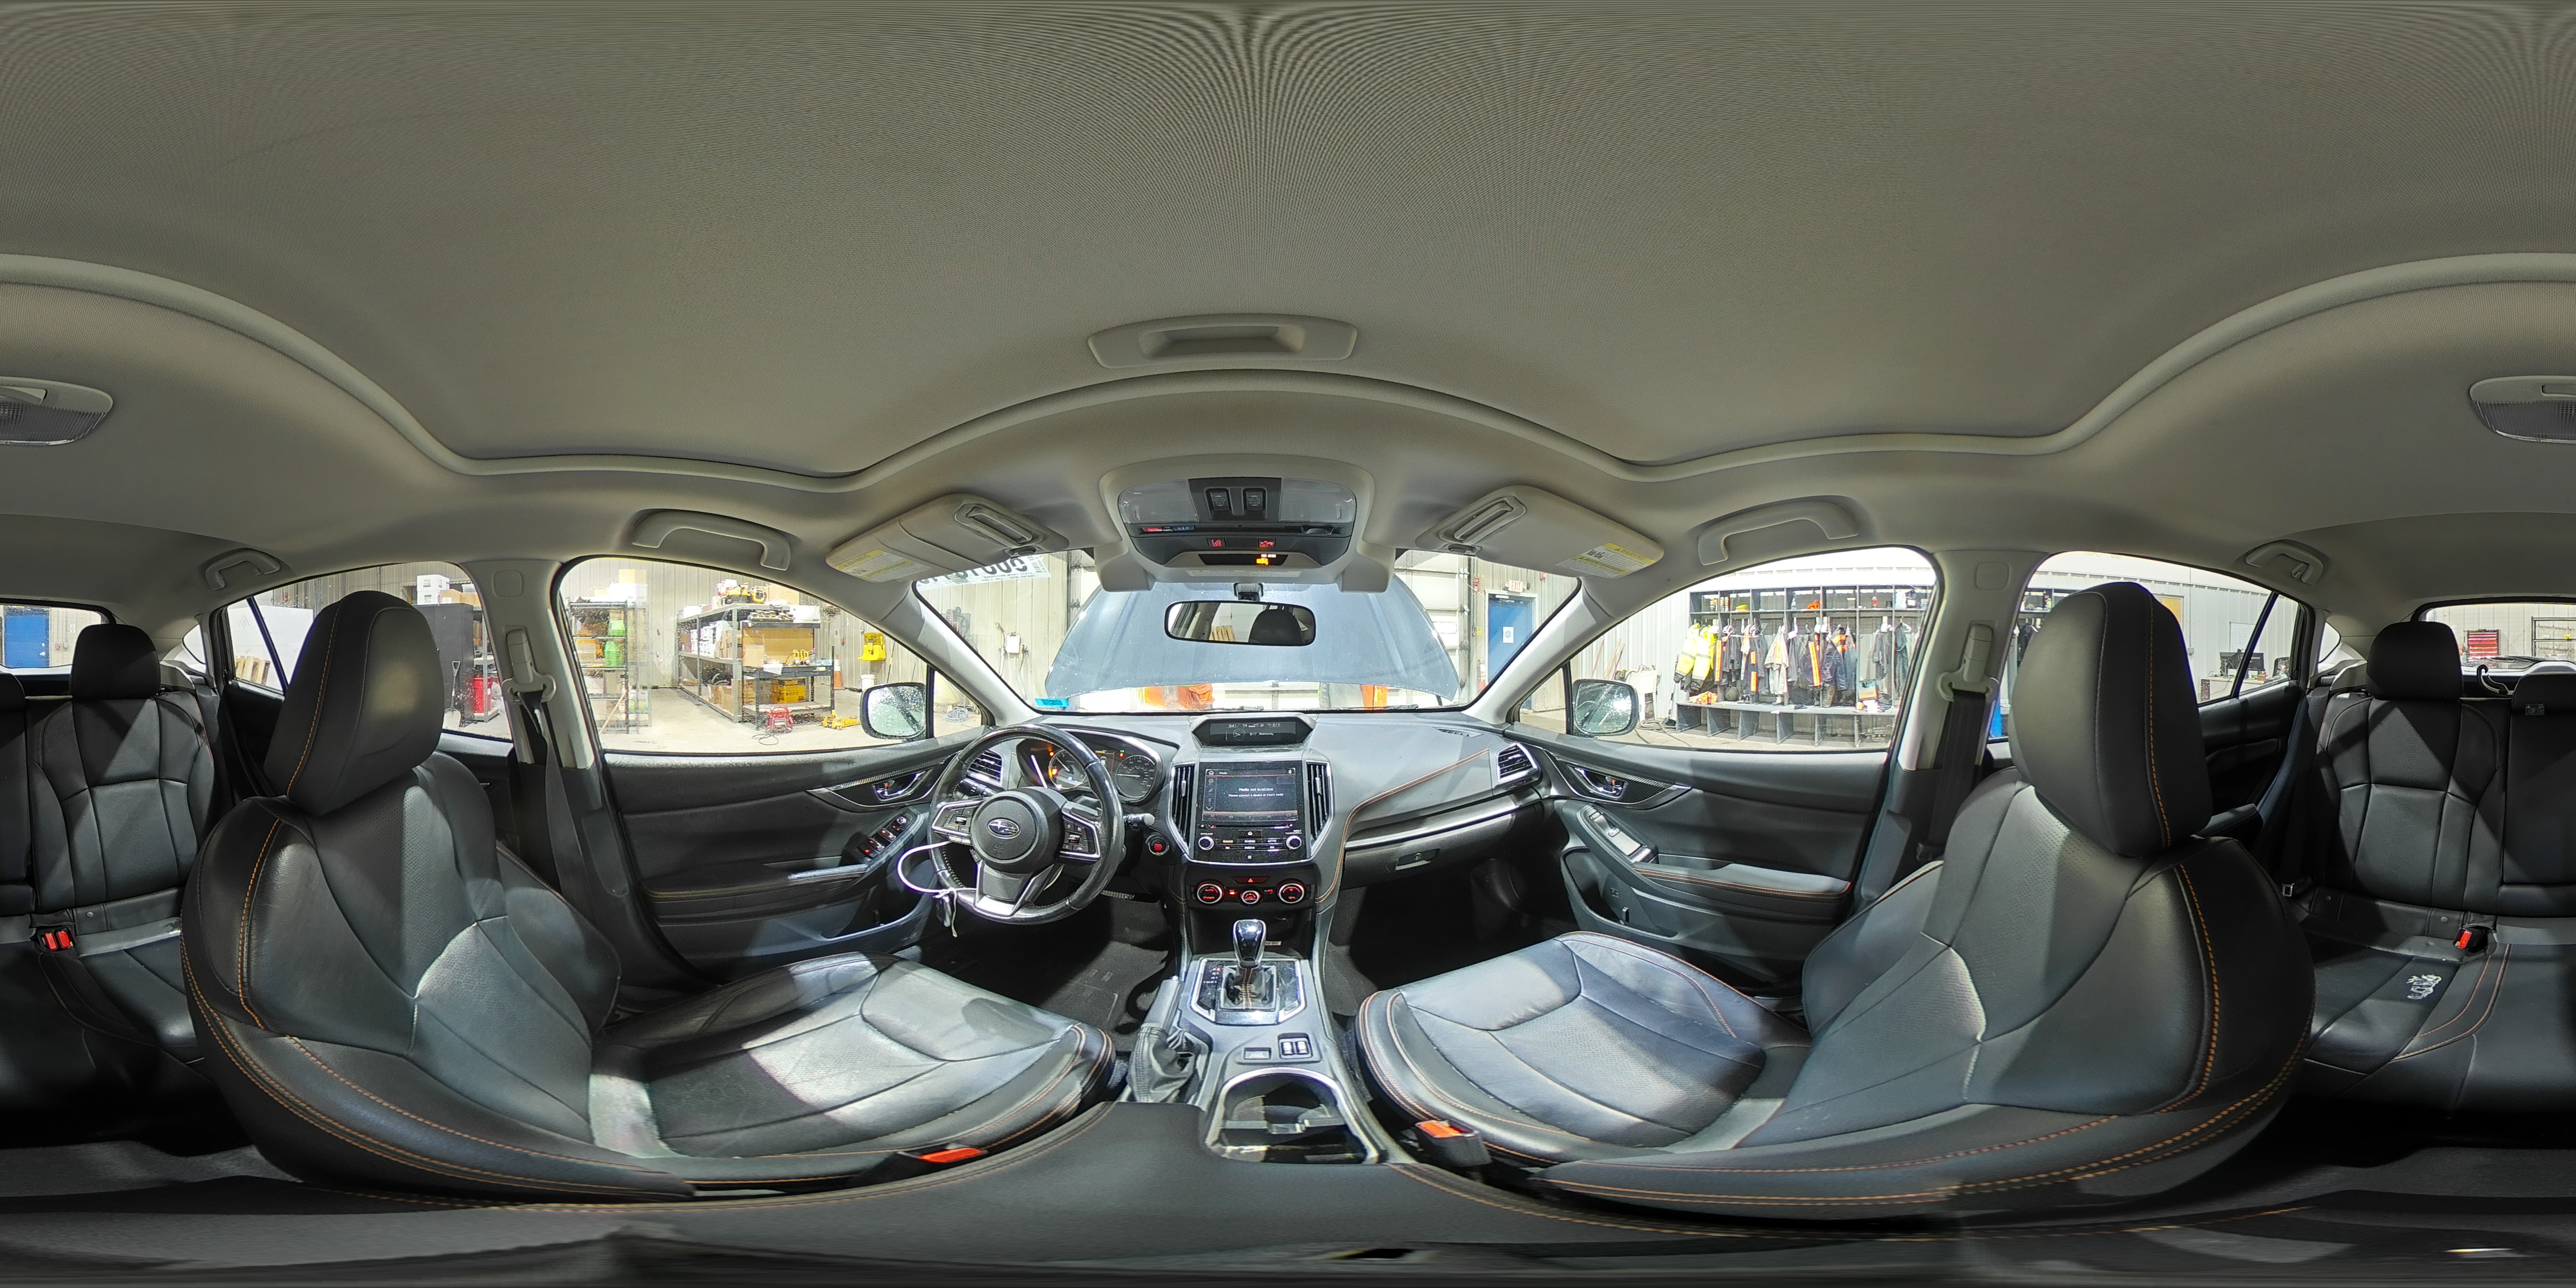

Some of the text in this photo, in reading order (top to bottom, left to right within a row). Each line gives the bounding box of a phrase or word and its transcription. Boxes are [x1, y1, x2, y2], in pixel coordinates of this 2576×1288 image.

[847, 554, 870, 566] WARNING
[1621, 548, 1645, 561] WARNING
[1584, 557, 1626, 573] AVERTISSEMENT
[1511, 581, 1521, 591] EXIT
